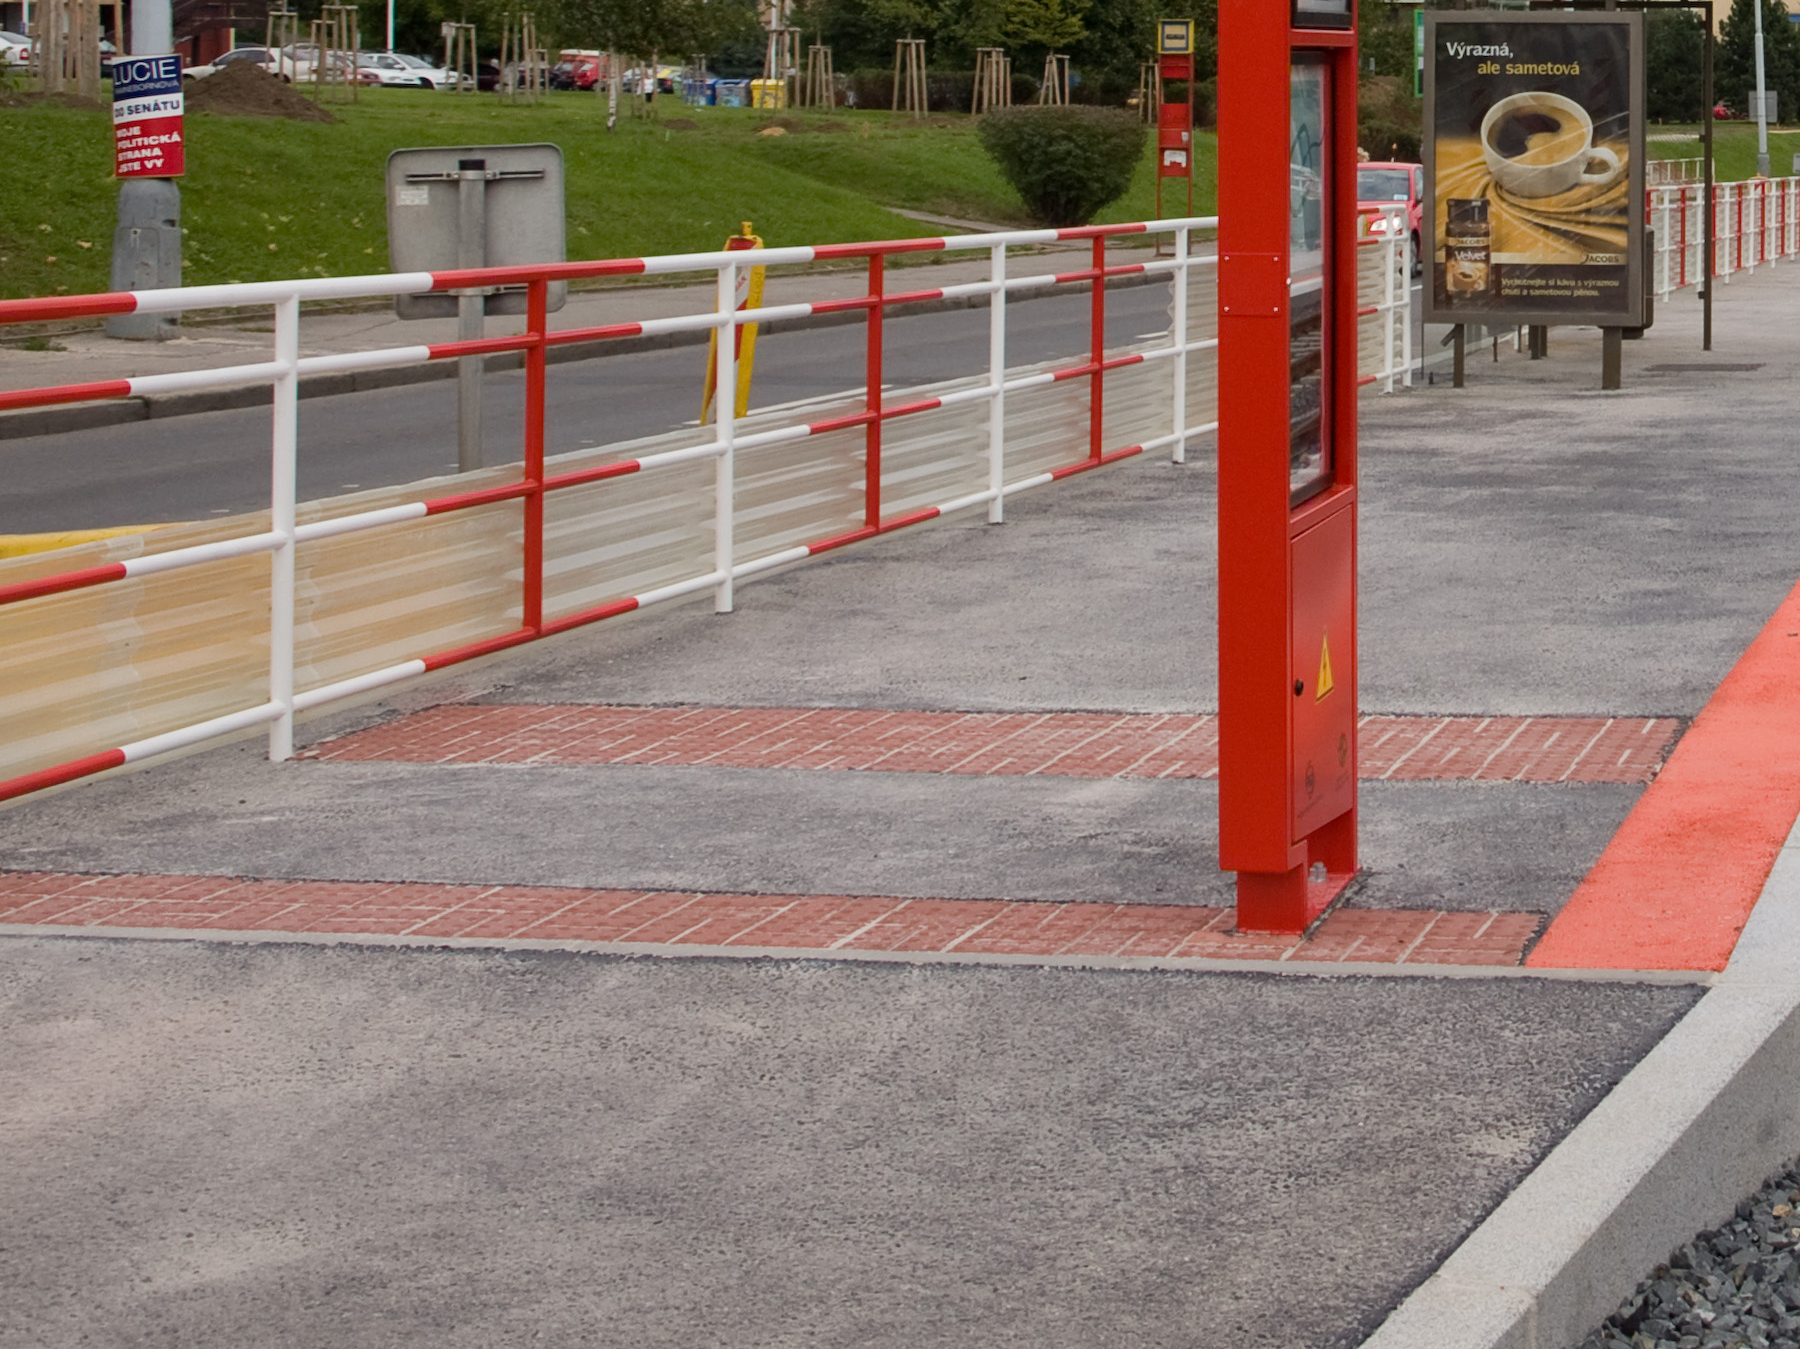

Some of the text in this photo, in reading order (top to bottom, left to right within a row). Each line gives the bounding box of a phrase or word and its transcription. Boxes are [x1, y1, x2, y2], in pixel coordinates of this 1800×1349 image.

[1446, 41, 1514, 59] Výrazná,
[113, 58, 177, 86] LUCIE
[1477, 60, 1580, 75] ale sametová
[127, 100, 180, 116] SENÁTU
[118, 132, 181, 149] POLITICKÁ
[118, 148, 162, 161] STRANA
[118, 159, 165, 173] JSTE VY
